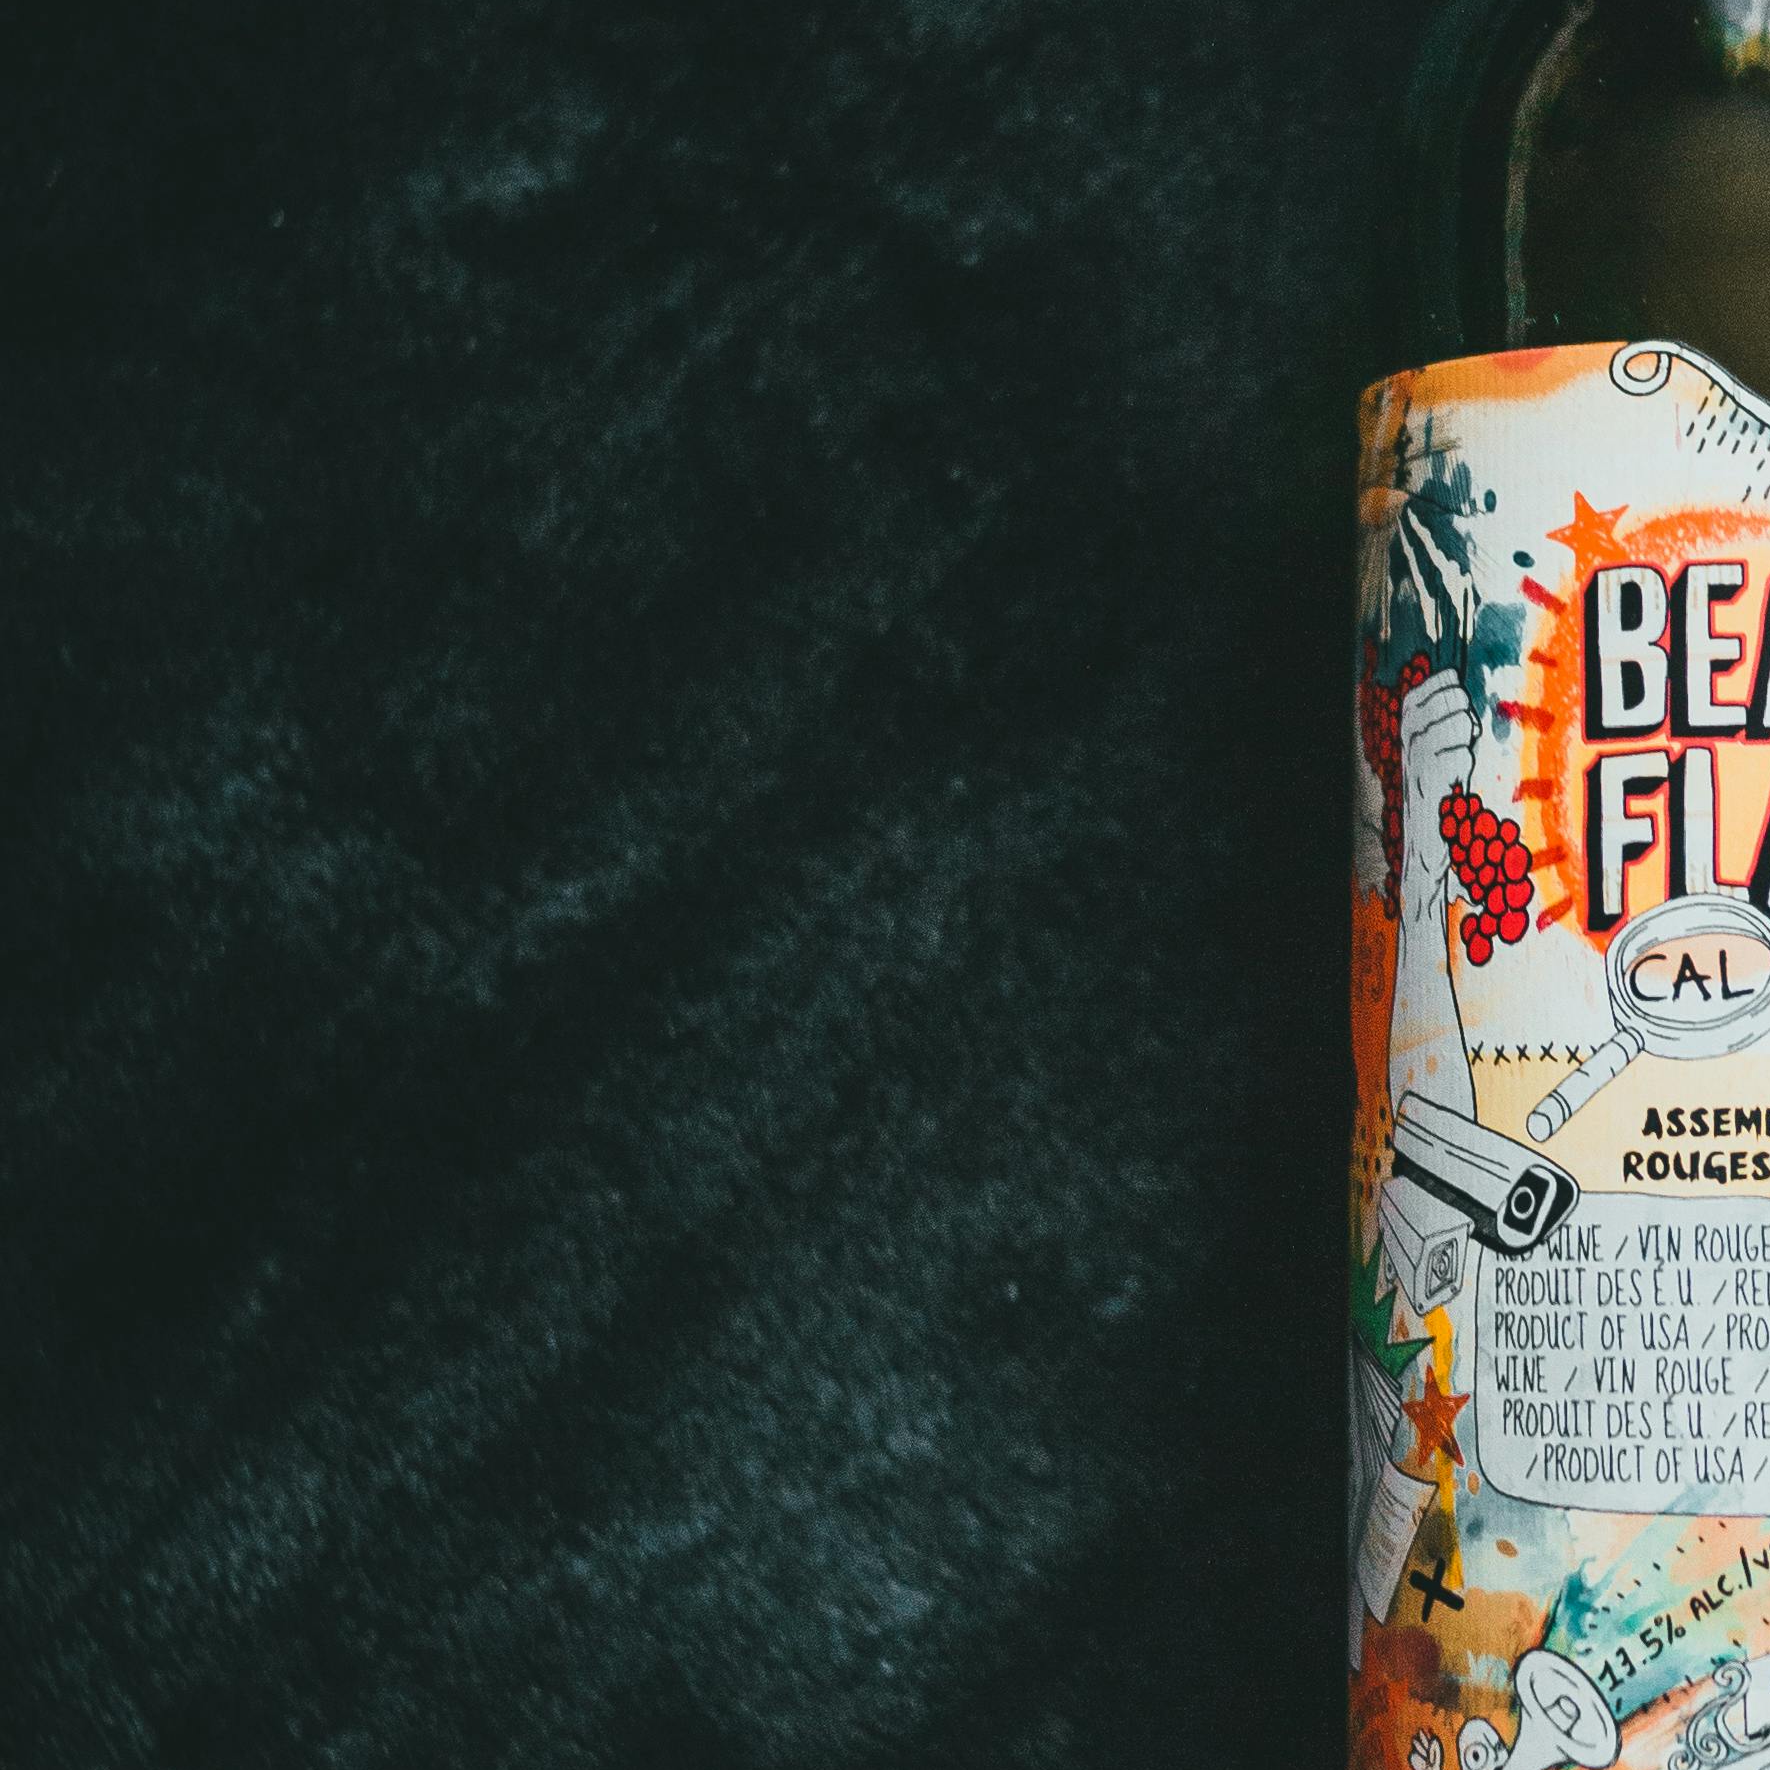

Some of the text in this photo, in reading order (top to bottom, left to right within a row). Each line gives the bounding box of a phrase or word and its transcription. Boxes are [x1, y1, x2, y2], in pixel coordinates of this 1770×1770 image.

[1548, 1224, 1602, 1261] WINE
[1638, 1224, 1681, 1262] VIN
[1495, 1267, 1586, 1306] PRODUIT
[1598, 1268, 1642, 1307] DES
[1495, 1311, 1588, 1350] PRODUCT
[1600, 1314, 1627, 1350] OF
[1640, 1312, 1689, 1351] USA
[1495, 1355, 1548, 1393] WINE
[1594, 1356, 1635, 1394] VIN
[1656, 1356, 1734, 1394] ROUGE
[1503, 1398, 1596, 1438] PRODUIT
[1607, 1401, 1652, 1439] DES
[1656, 1447, 1682, 1483] OF
[1695, 1445, 1744, 1484] USA
[1599, 1613, 1686, 1692] 13.5%
